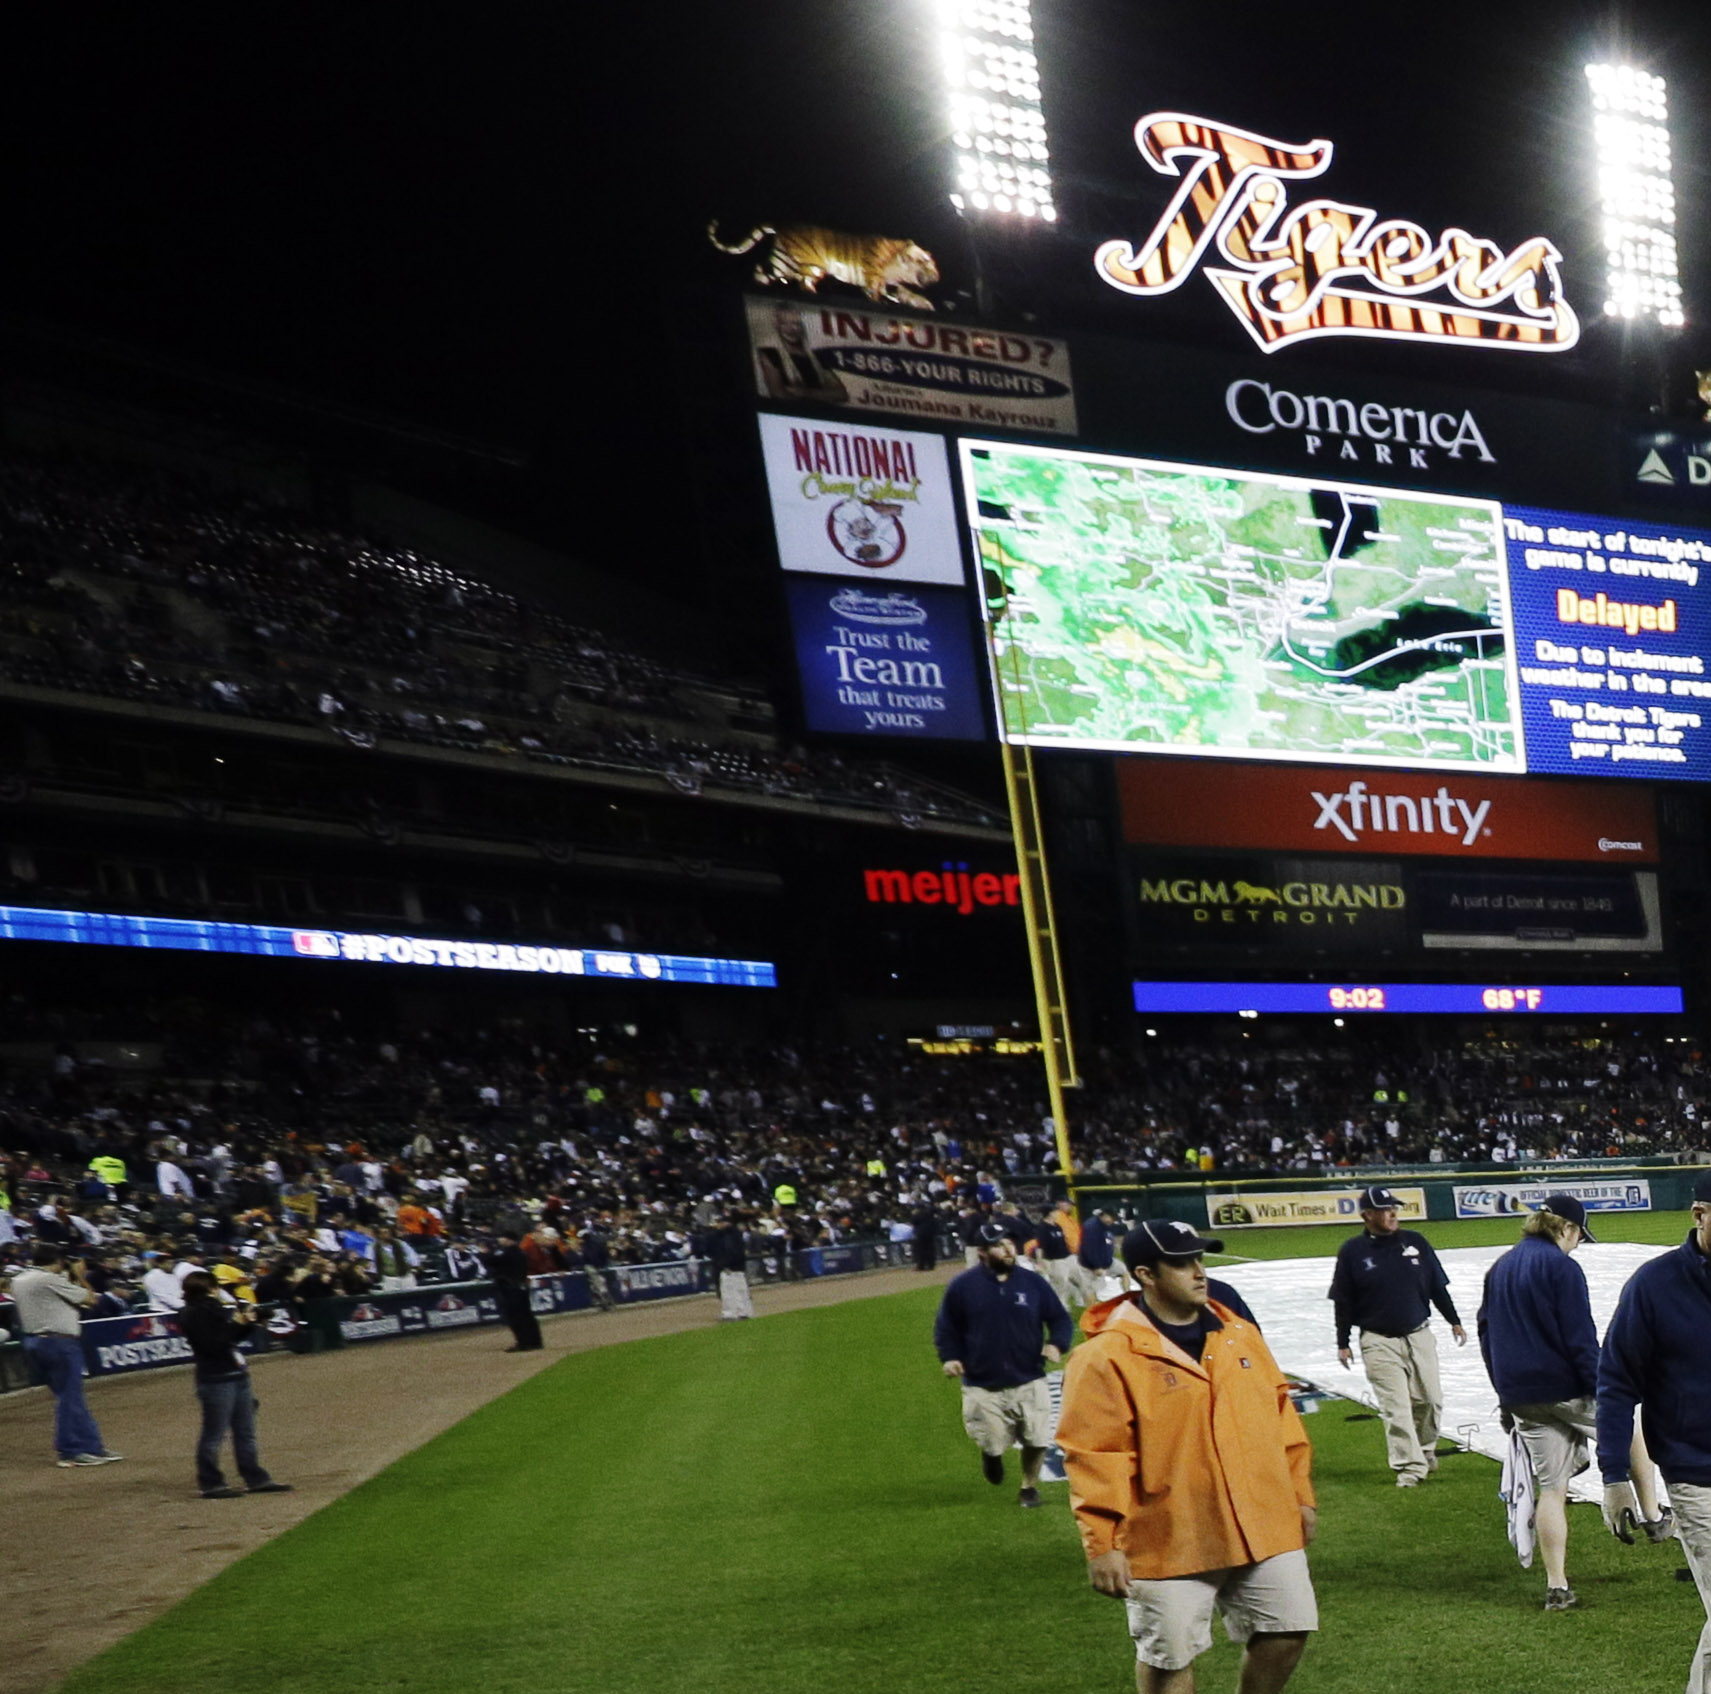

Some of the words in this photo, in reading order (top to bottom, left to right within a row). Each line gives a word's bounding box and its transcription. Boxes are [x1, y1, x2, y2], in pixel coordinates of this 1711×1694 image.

[1095, 112, 1580, 353] Tigers
[820, 309, 1055, 367] INJURED?
[834, 351, 963, 385] 1-866-YOUR
[967, 370, 1046, 394] RIGHTS
[857, 388, 962, 417] Joumana
[790, 427, 923, 484] NATIONAL
[1304, 434, 1430, 470] PARK
[1503, 518, 1545, 543] The
[1547, 526, 1602, 550] start
[1604, 531, 1627, 552] of
[1524, 548, 1584, 571] game
[1586, 550, 1606, 572] is
[1609, 556, 1699, 587] currently
[1556, 588, 1678, 635] Delayed
[832, 625, 889, 650] Trust
[895, 631, 932, 652] the
[825, 645, 946, 689] Team
[1534, 639, 1579, 663] Due
[1580, 646, 1606, 665] to
[1608, 646, 1705, 674] inclement
[1520, 667, 1606, 688] weather
[1607, 669, 1628, 691] in
[1631, 672, 1667, 694] the
[836, 686, 881, 707] that
[887, 691, 946, 710] treats
[1549, 699, 1584, 719] The
[1585, 702, 1648, 724] Detroit
[1648, 706, 1702, 729] Tigers
[863, 708, 926, 731] yours
[1571, 721, 1622, 741] thank
[1623, 727, 1656, 744] you
[1657, 727, 1685, 744] for
[1569, 741, 1611, 759] your
[1311, 781, 1491, 846] xfinity
[863, 860, 1021, 915] meijer
[1140, 878, 1231, 904] MGM
[1282, 881, 1406, 909] GRAND
[1193, 908, 1358, 925] DETROIT
[338, 932, 586, 975] #POSTSEASON
[1328, 986, 1385, 1009] 9:02
[1219, 1206, 1246, 1224] ER
[1255, 1202, 1287, 1218] Wait
[1289, 1201, 1326, 1217] Times
